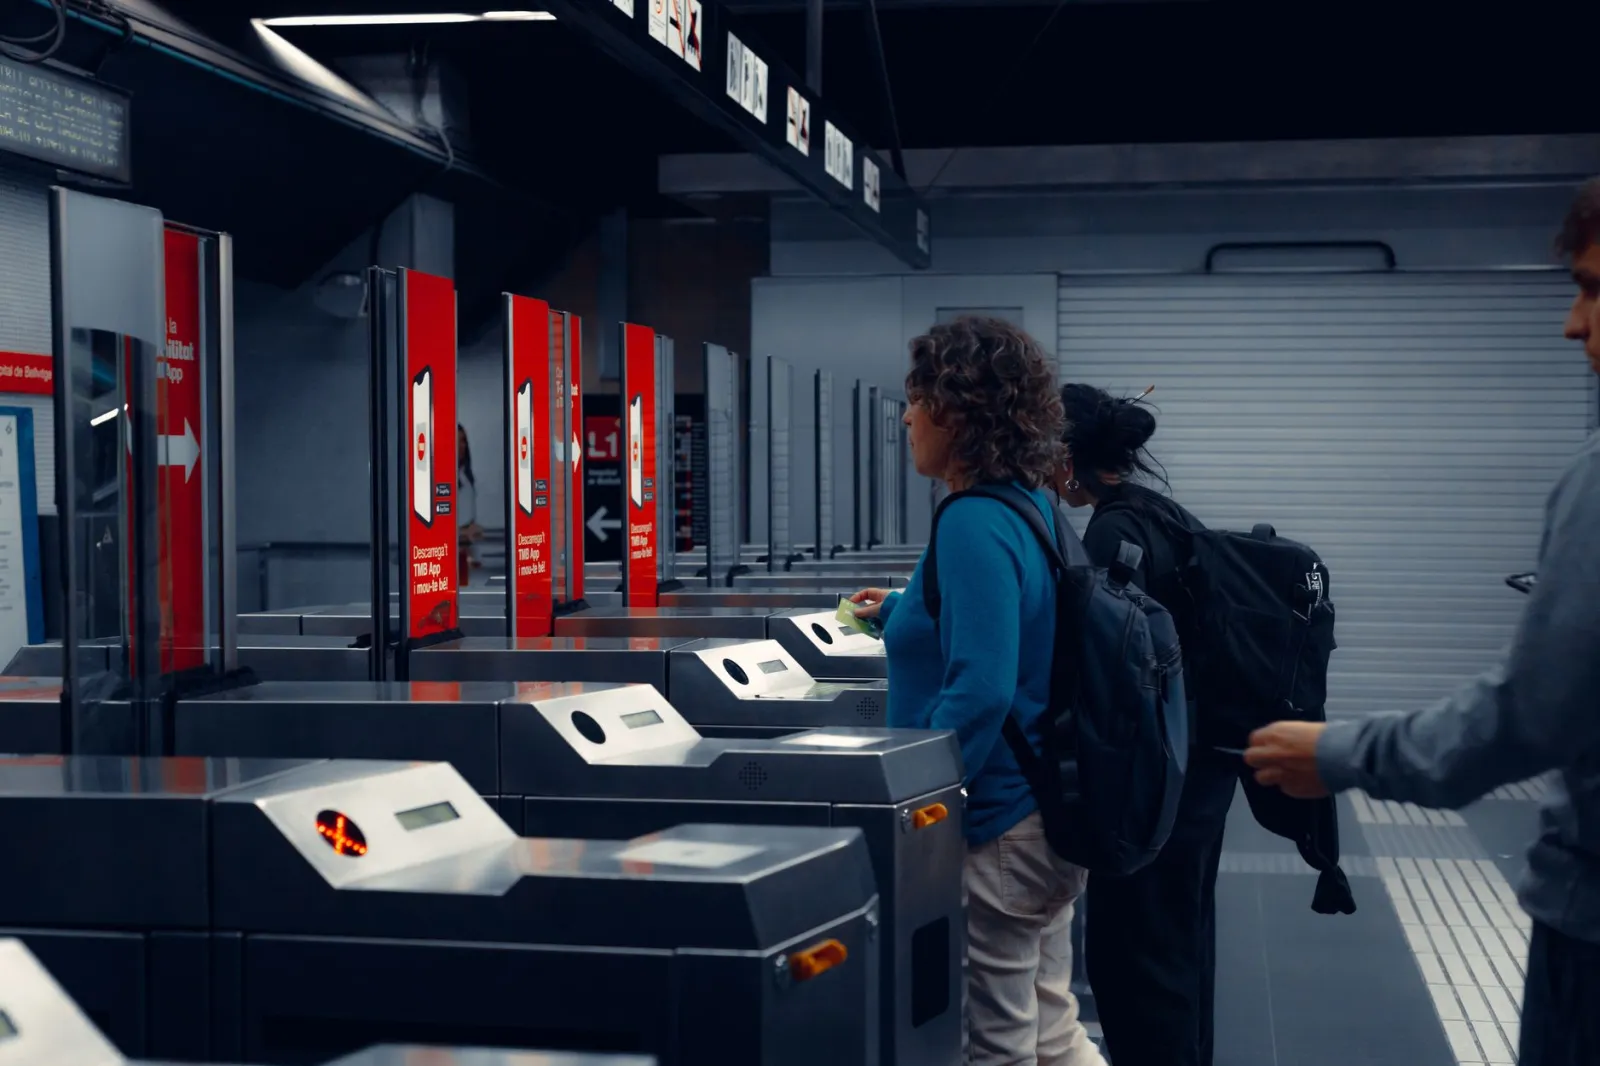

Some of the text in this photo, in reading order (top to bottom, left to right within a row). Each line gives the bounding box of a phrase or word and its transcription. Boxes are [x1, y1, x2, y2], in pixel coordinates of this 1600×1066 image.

[588, 431, 617, 457] L1
[518, 548, 540, 562] TMB App
[413, 562, 441, 578] TMB App
[416, 579, 438, 595] mou-te
